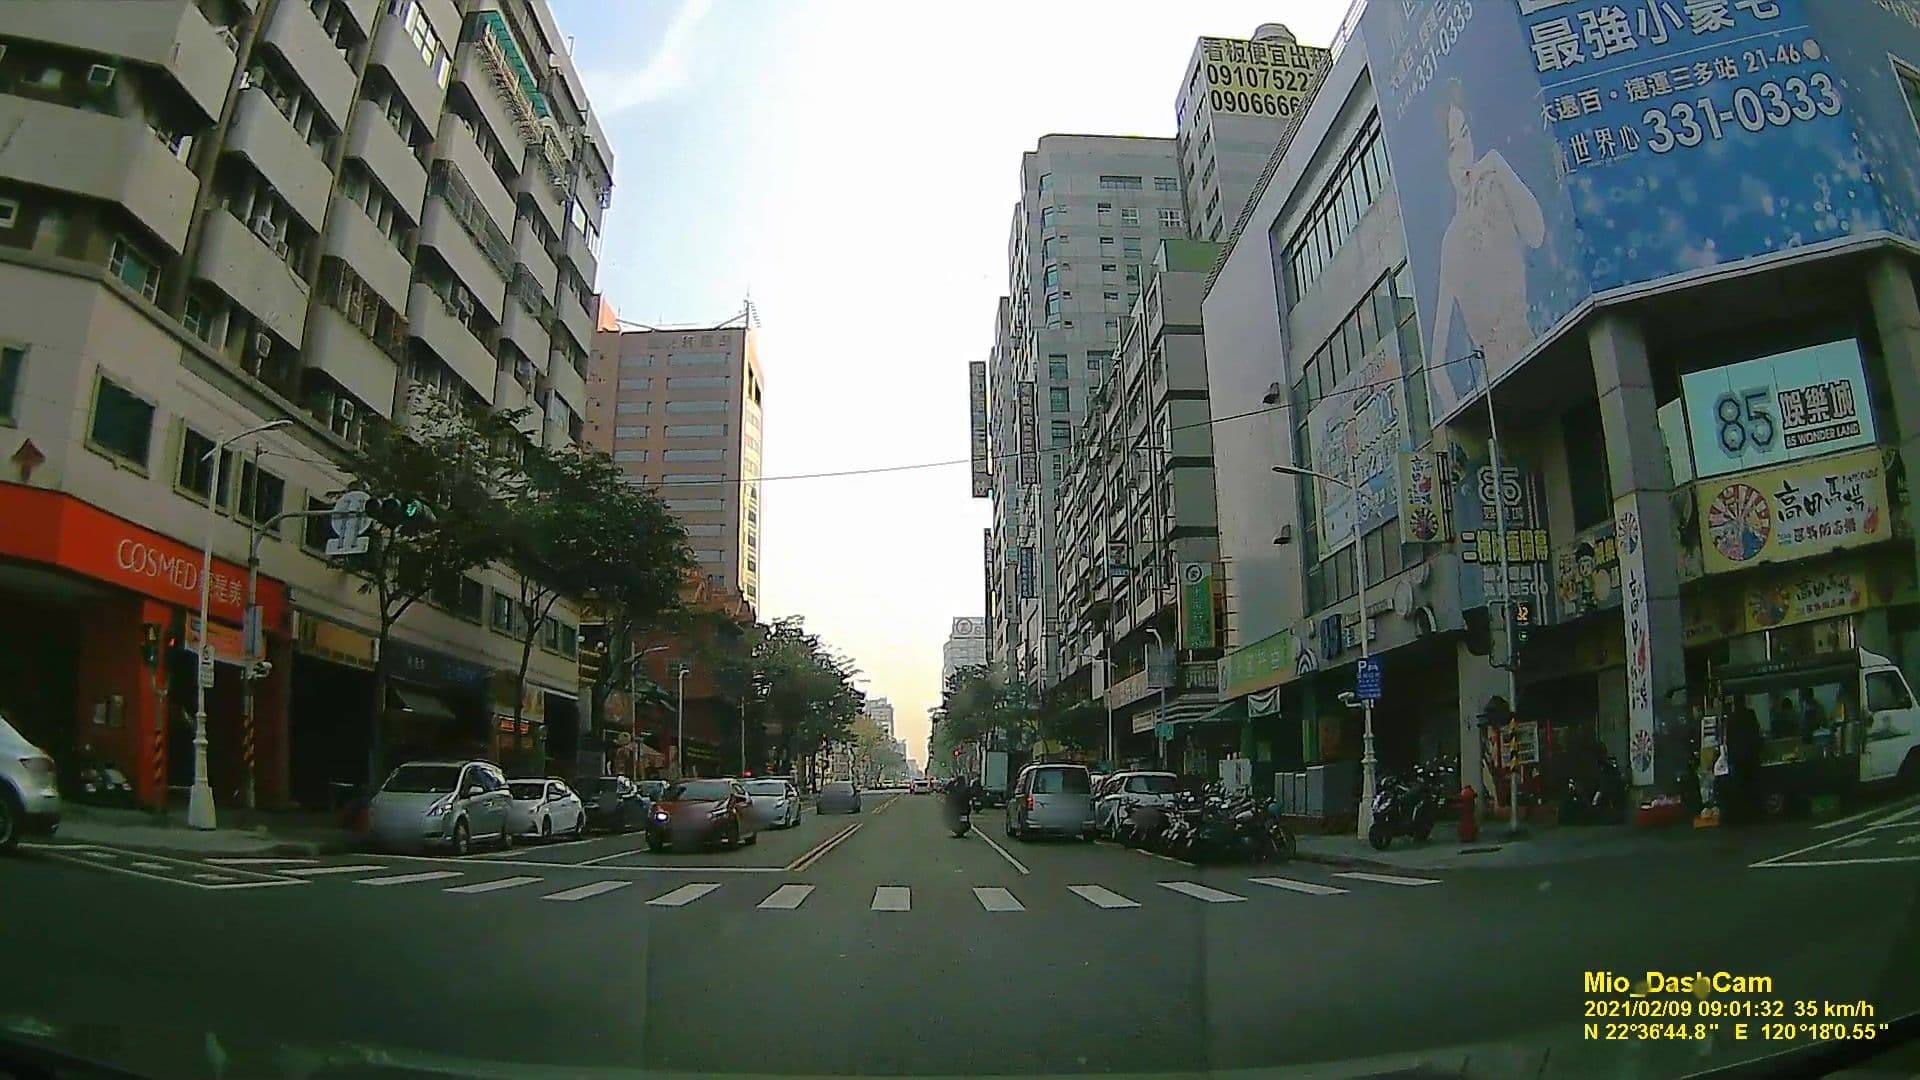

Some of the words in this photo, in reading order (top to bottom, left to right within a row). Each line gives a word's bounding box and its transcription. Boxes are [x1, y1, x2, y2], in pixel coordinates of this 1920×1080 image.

[1642, 72, 1842, 153] 331-0333
[1716, 386, 1774, 455] 85
[1797, 428, 1836, 444] WONDER
[1836, 423, 1860, 437] LAND
[118, 539, 198, 590] COSMED
